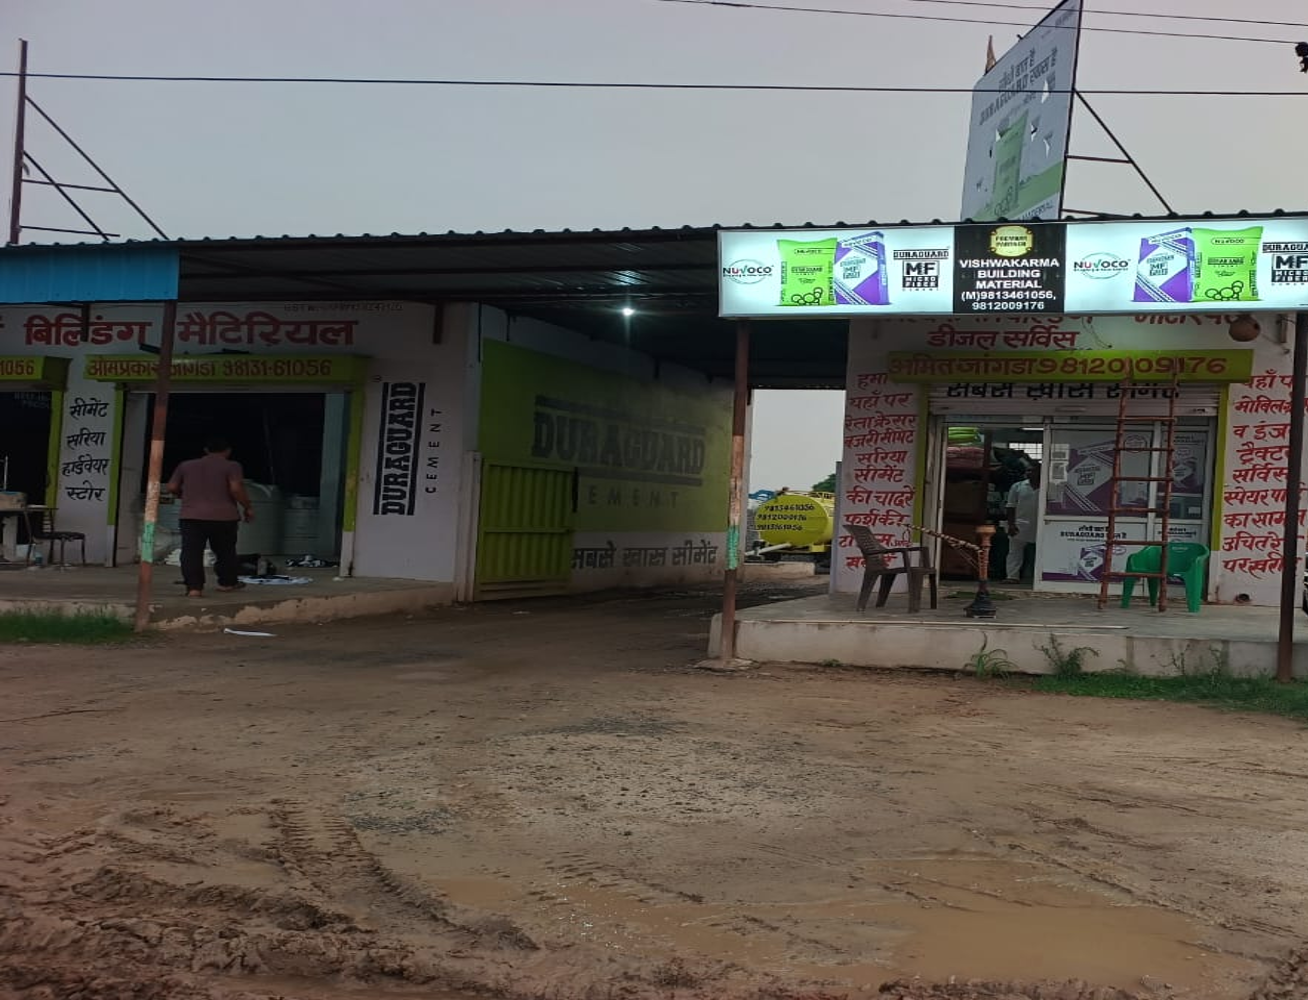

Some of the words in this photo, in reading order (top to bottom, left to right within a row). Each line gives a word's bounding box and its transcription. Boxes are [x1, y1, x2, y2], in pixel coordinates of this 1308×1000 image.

[893, 249, 949, 260] DURAGUARD
[723, 262, 772, 276] NUVOCO
[960, 258, 1060, 270] VISHWAKARMA
[1073, 259, 1129, 271] NUVOCO
[977, 269, 1041, 279] BUILDING
[976, 279, 1042, 290] MATERIAL
[961, 291, 1056, 301] (M)9813461056,
[972, 301, 1044, 310] 9812009176
[926, 325, 997, 352] डीजल
[1004, 324, 1081, 352] सर्विस
[69, 398, 110, 420] सीमेंट
[66, 427, 106, 450] सरिया
[380, 382, 418, 515] DURAGUARD
[425, 408, 442, 493] CEMENT
[62, 454, 110, 476] हार्डवेयर
[65, 480, 105, 500] स्टोर
